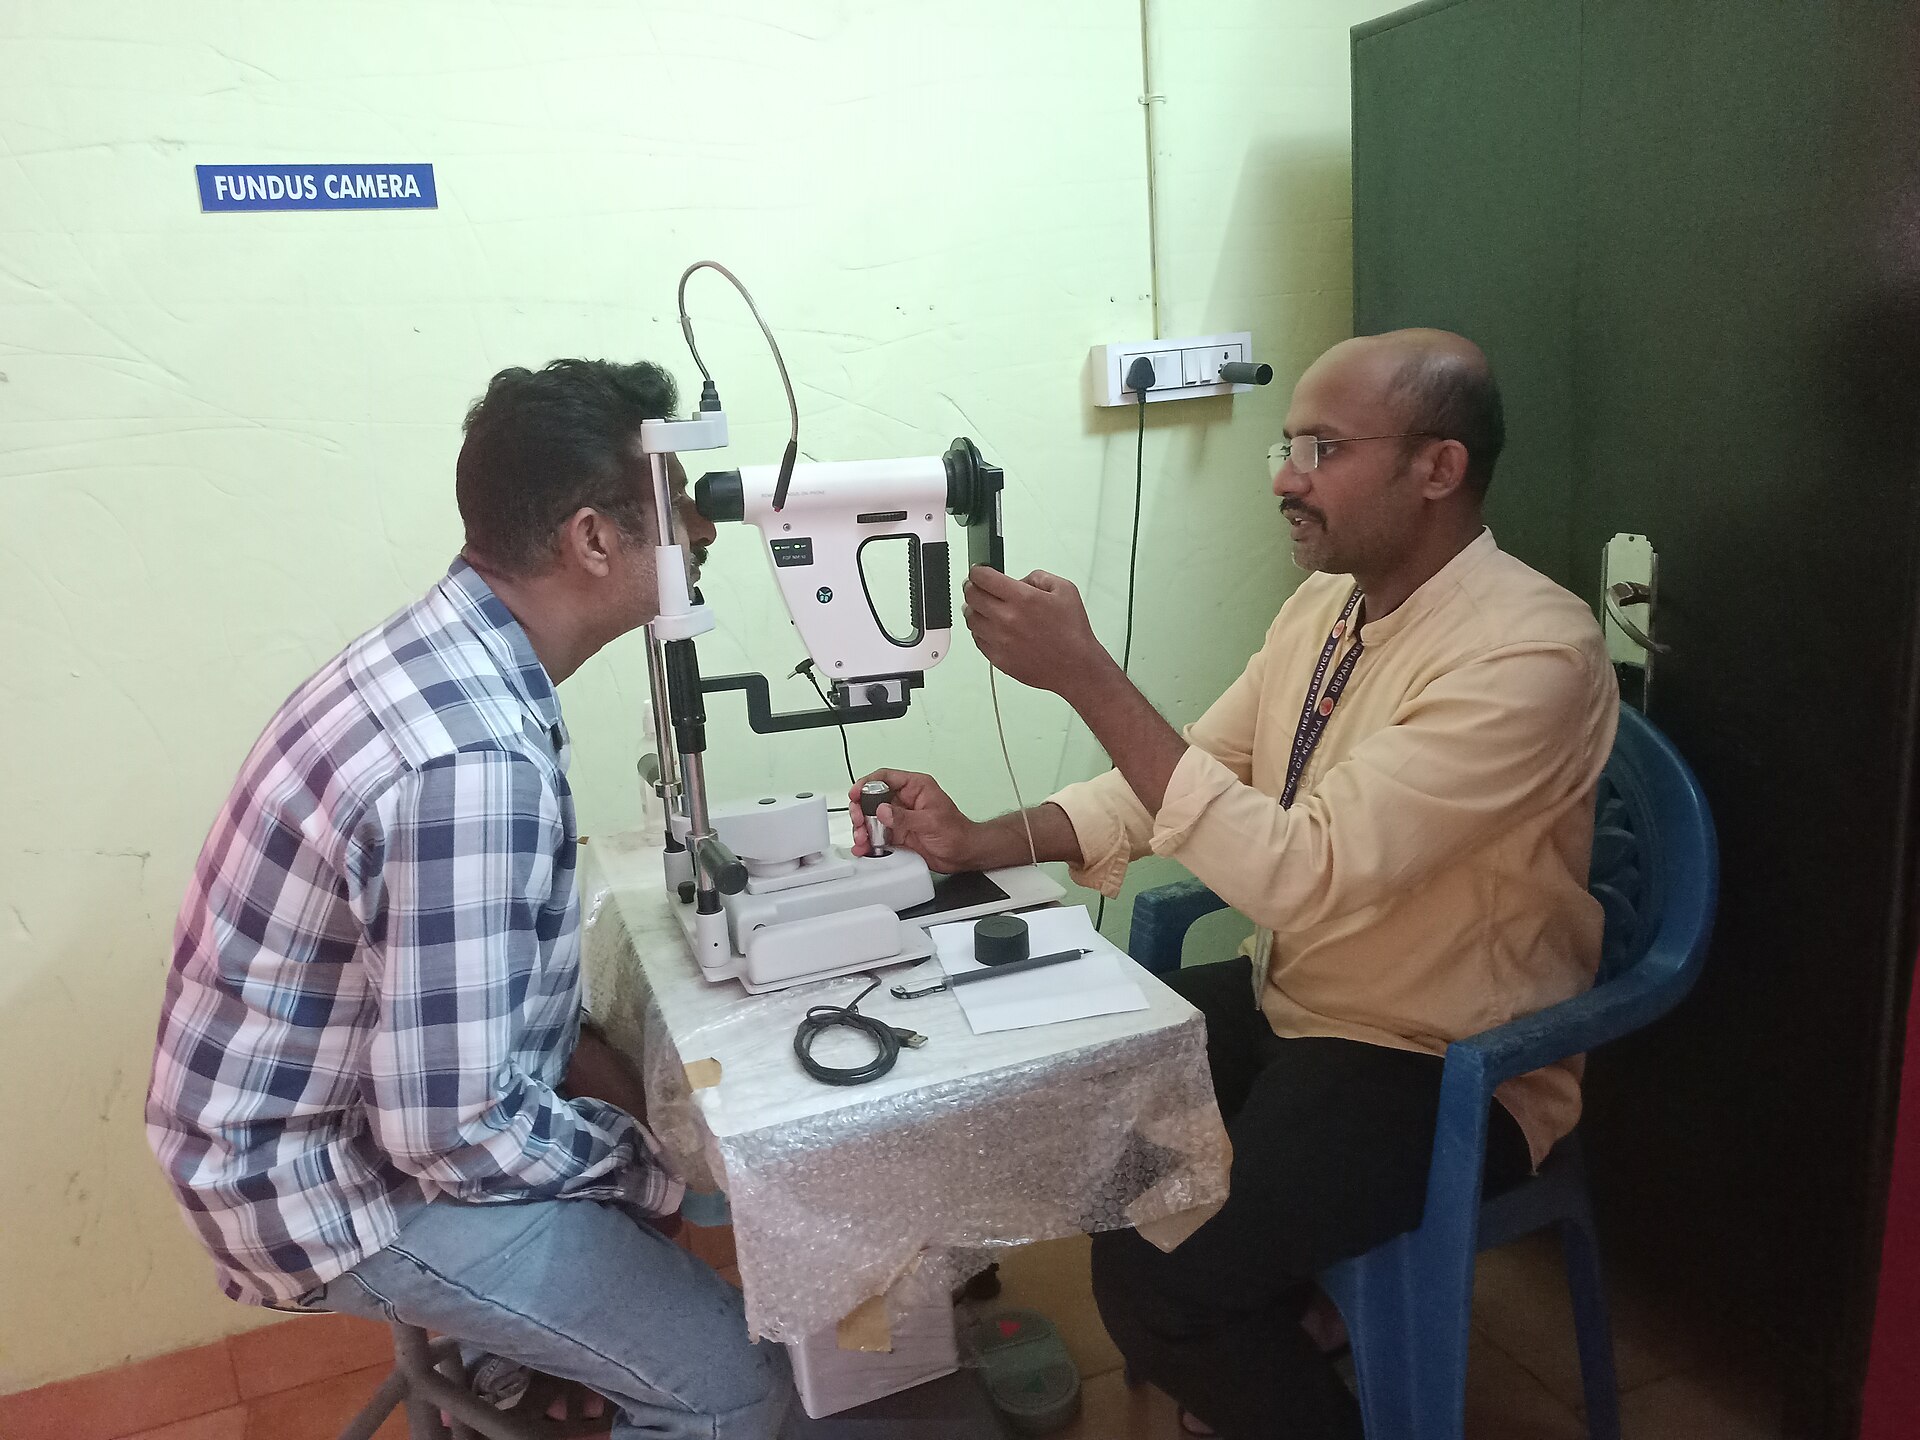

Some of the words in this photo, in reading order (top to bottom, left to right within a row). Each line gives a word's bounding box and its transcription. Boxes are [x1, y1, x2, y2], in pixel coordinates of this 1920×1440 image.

[214, 174, 318, 201] FUNDUS
[324, 174, 421, 199] CAMERA
[1296, 735, 1304, 747] OF
[1301, 693, 1315, 731] HEALTH
[1312, 644, 1334, 691] SERVICES
[1295, 757, 1303, 769] OF
[1302, 719, 1323, 755] KERALA
